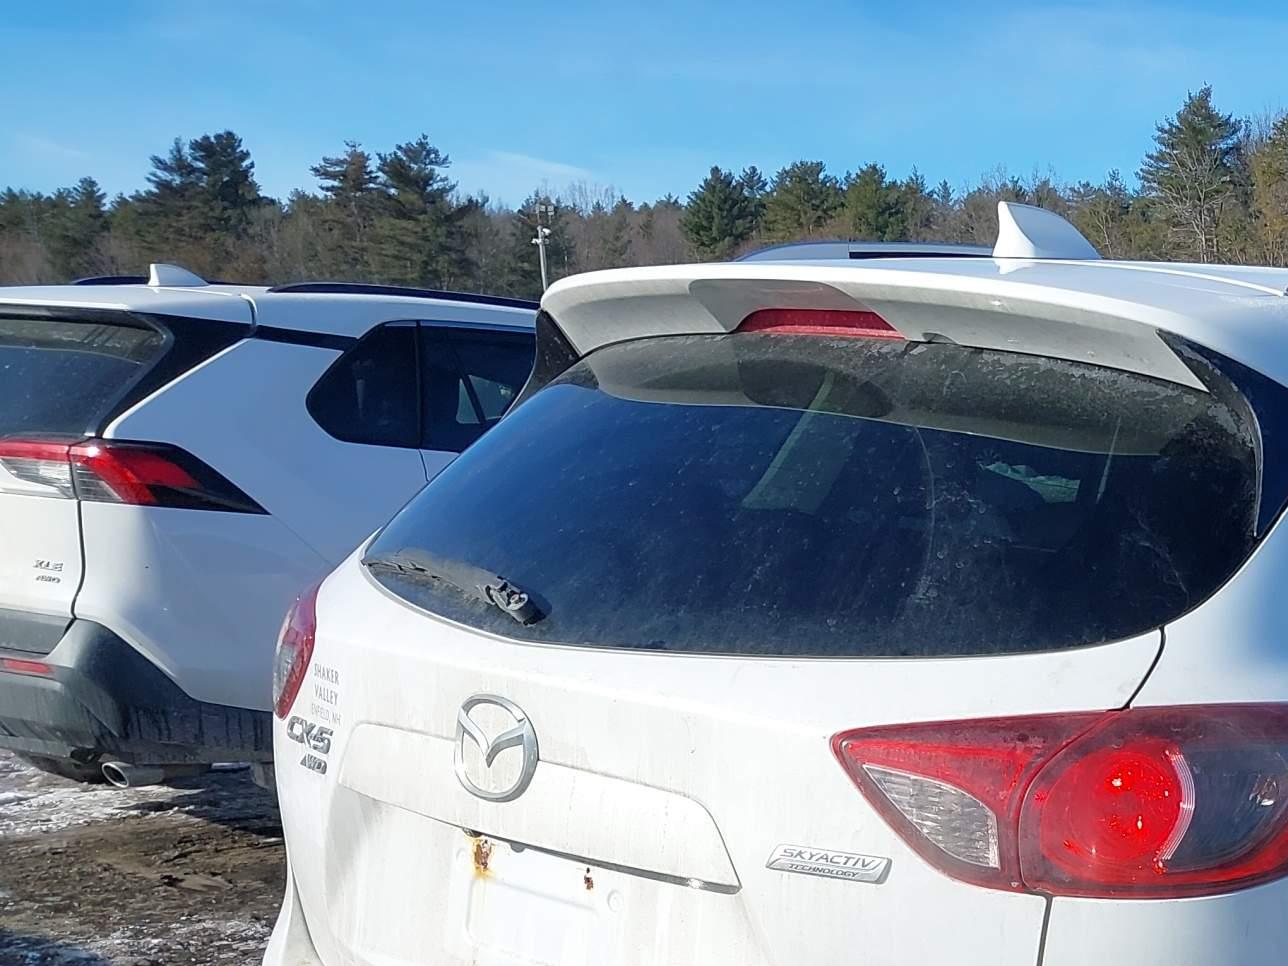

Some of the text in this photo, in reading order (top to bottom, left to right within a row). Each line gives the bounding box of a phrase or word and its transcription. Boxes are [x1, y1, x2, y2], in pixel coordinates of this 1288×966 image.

[314, 663, 340, 686] SHAKER
[314, 683, 338, 706] VALLEY
[287, 716, 334, 755] CX-5
[299, 753, 328, 775] AWD
[780, 848, 876, 869] SKYACTIV
[789, 863, 859, 878] TECHNOLOGY
